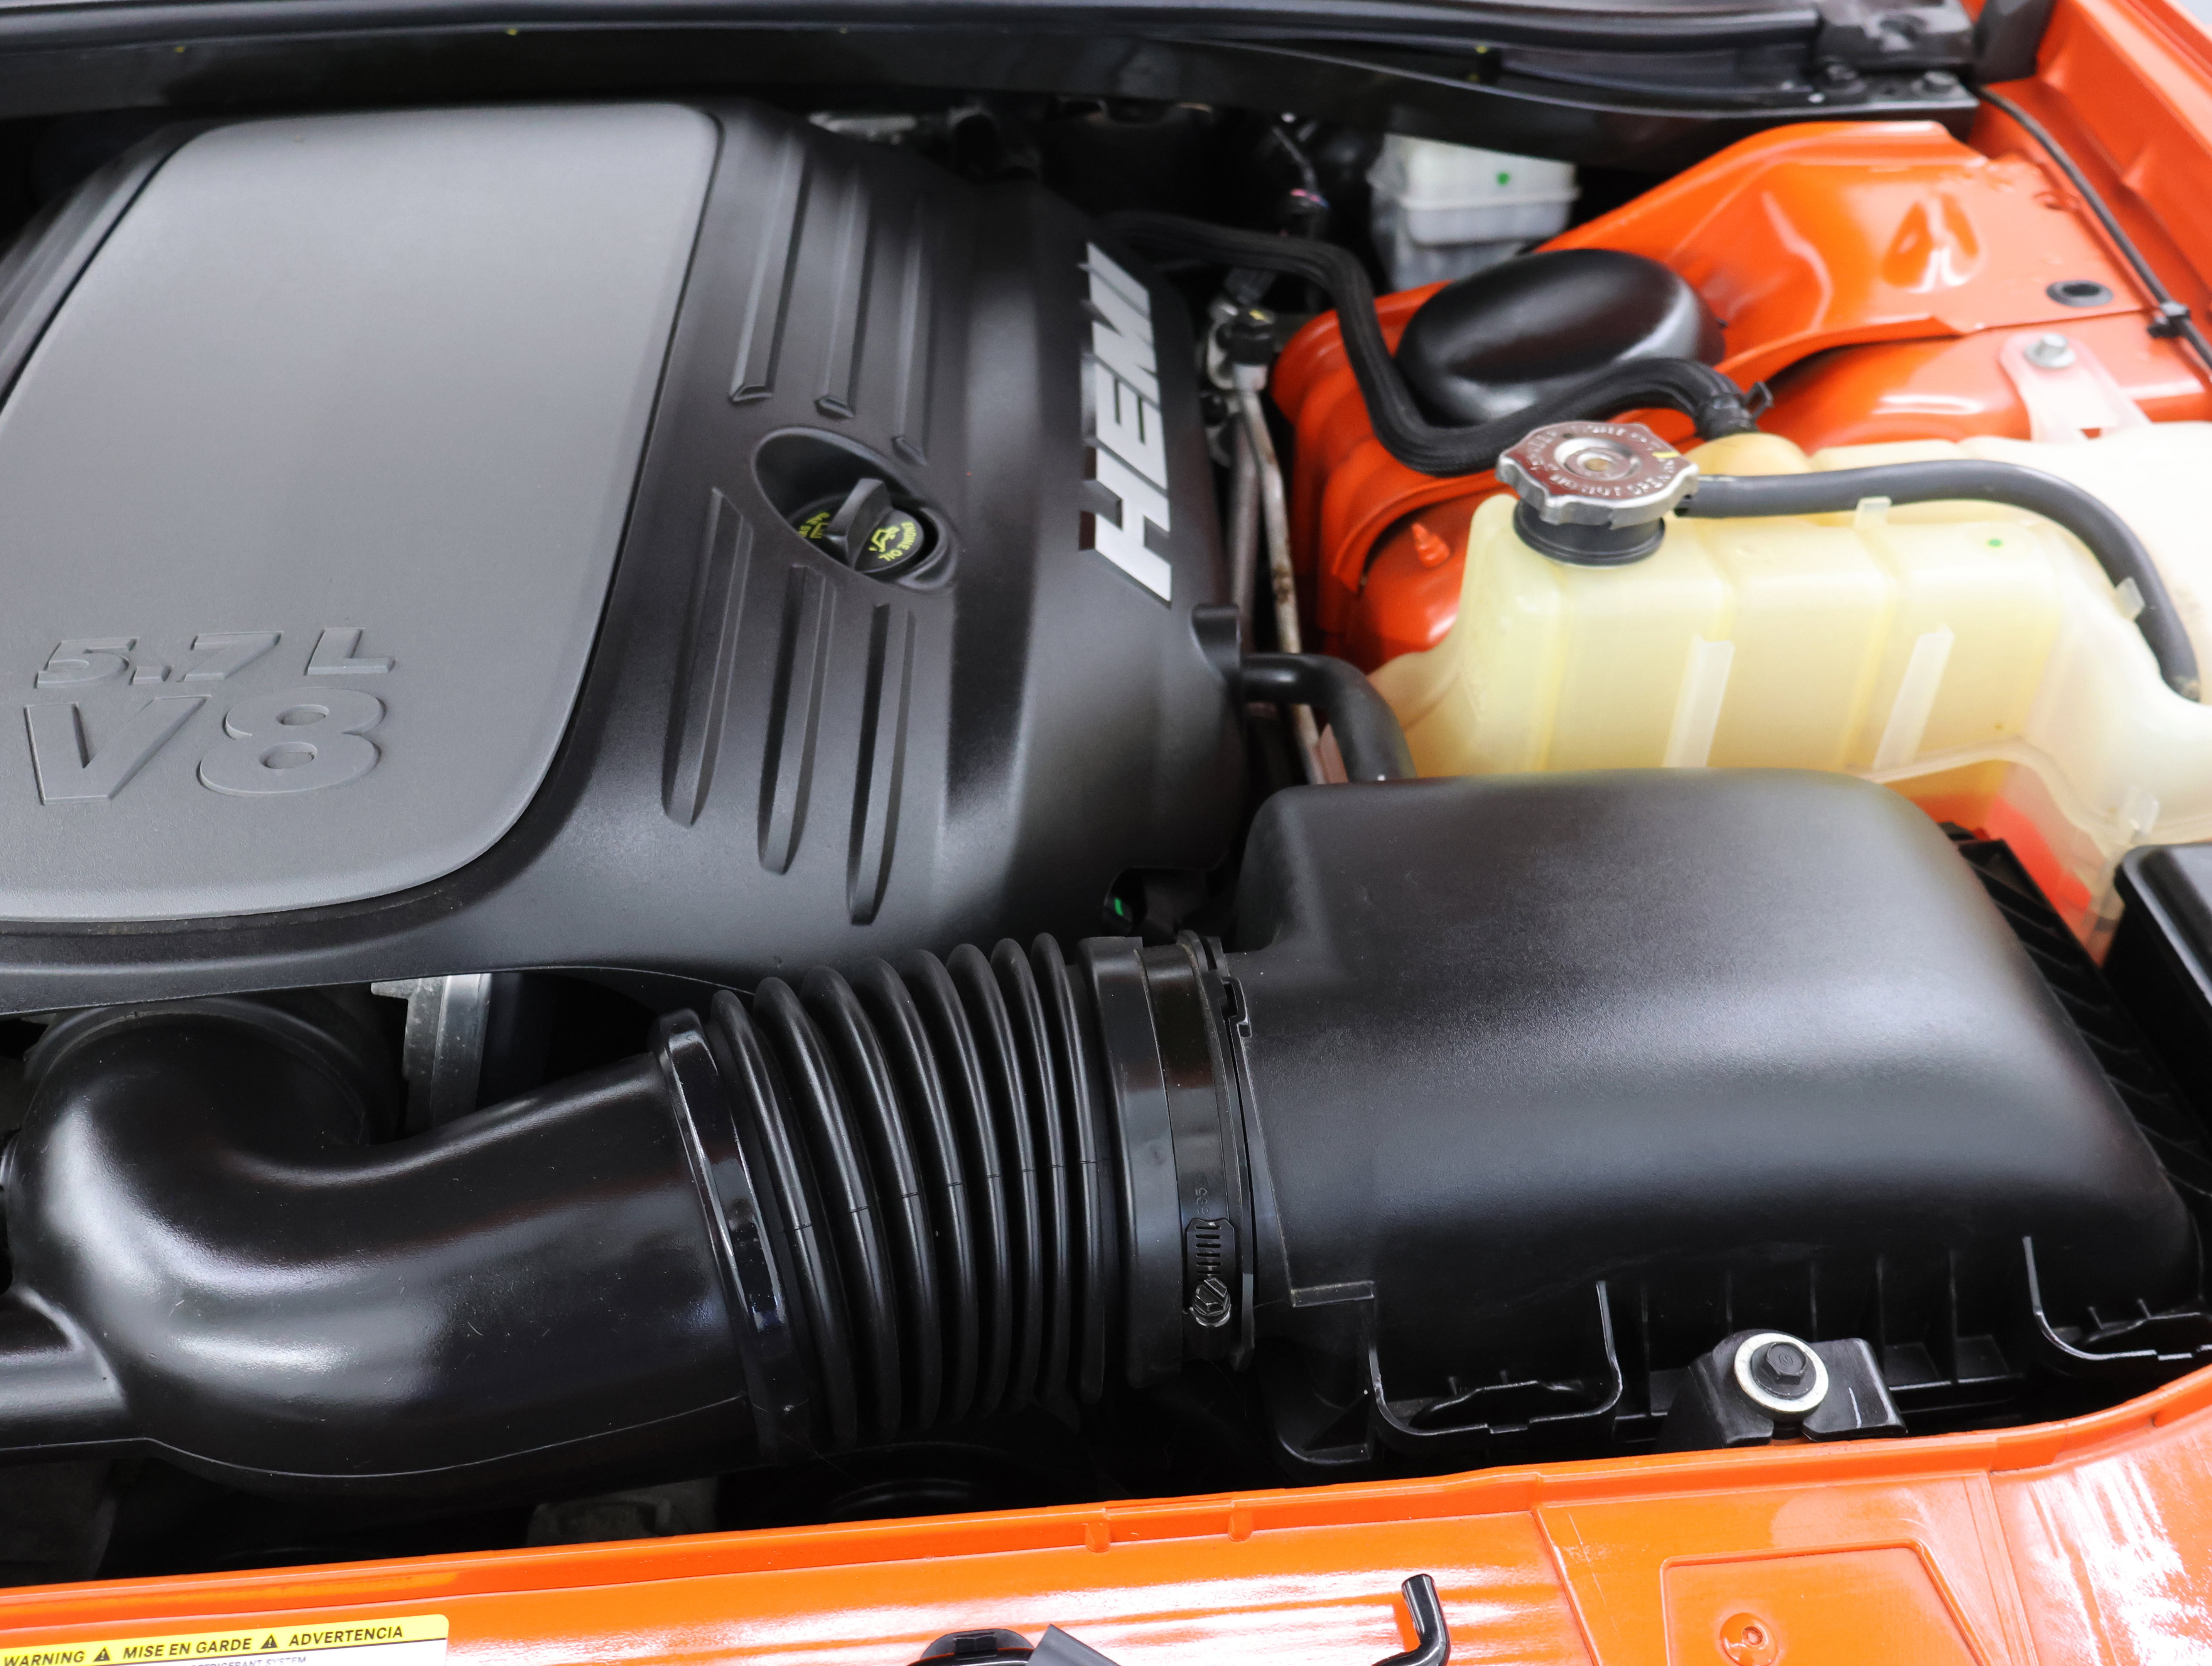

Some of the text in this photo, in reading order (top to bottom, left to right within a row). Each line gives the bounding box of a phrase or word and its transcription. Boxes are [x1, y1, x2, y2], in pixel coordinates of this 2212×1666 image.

[1081, 241, 1172, 605] HEMI
[878, 521, 917, 562] ENGINE OIL
[34, 627, 396, 689] 5.7 L
[24, 687, 386, 806] V8
[3, 1626, 403, 1666] WARNING MISE EN GARDE ADVERTENCIA
